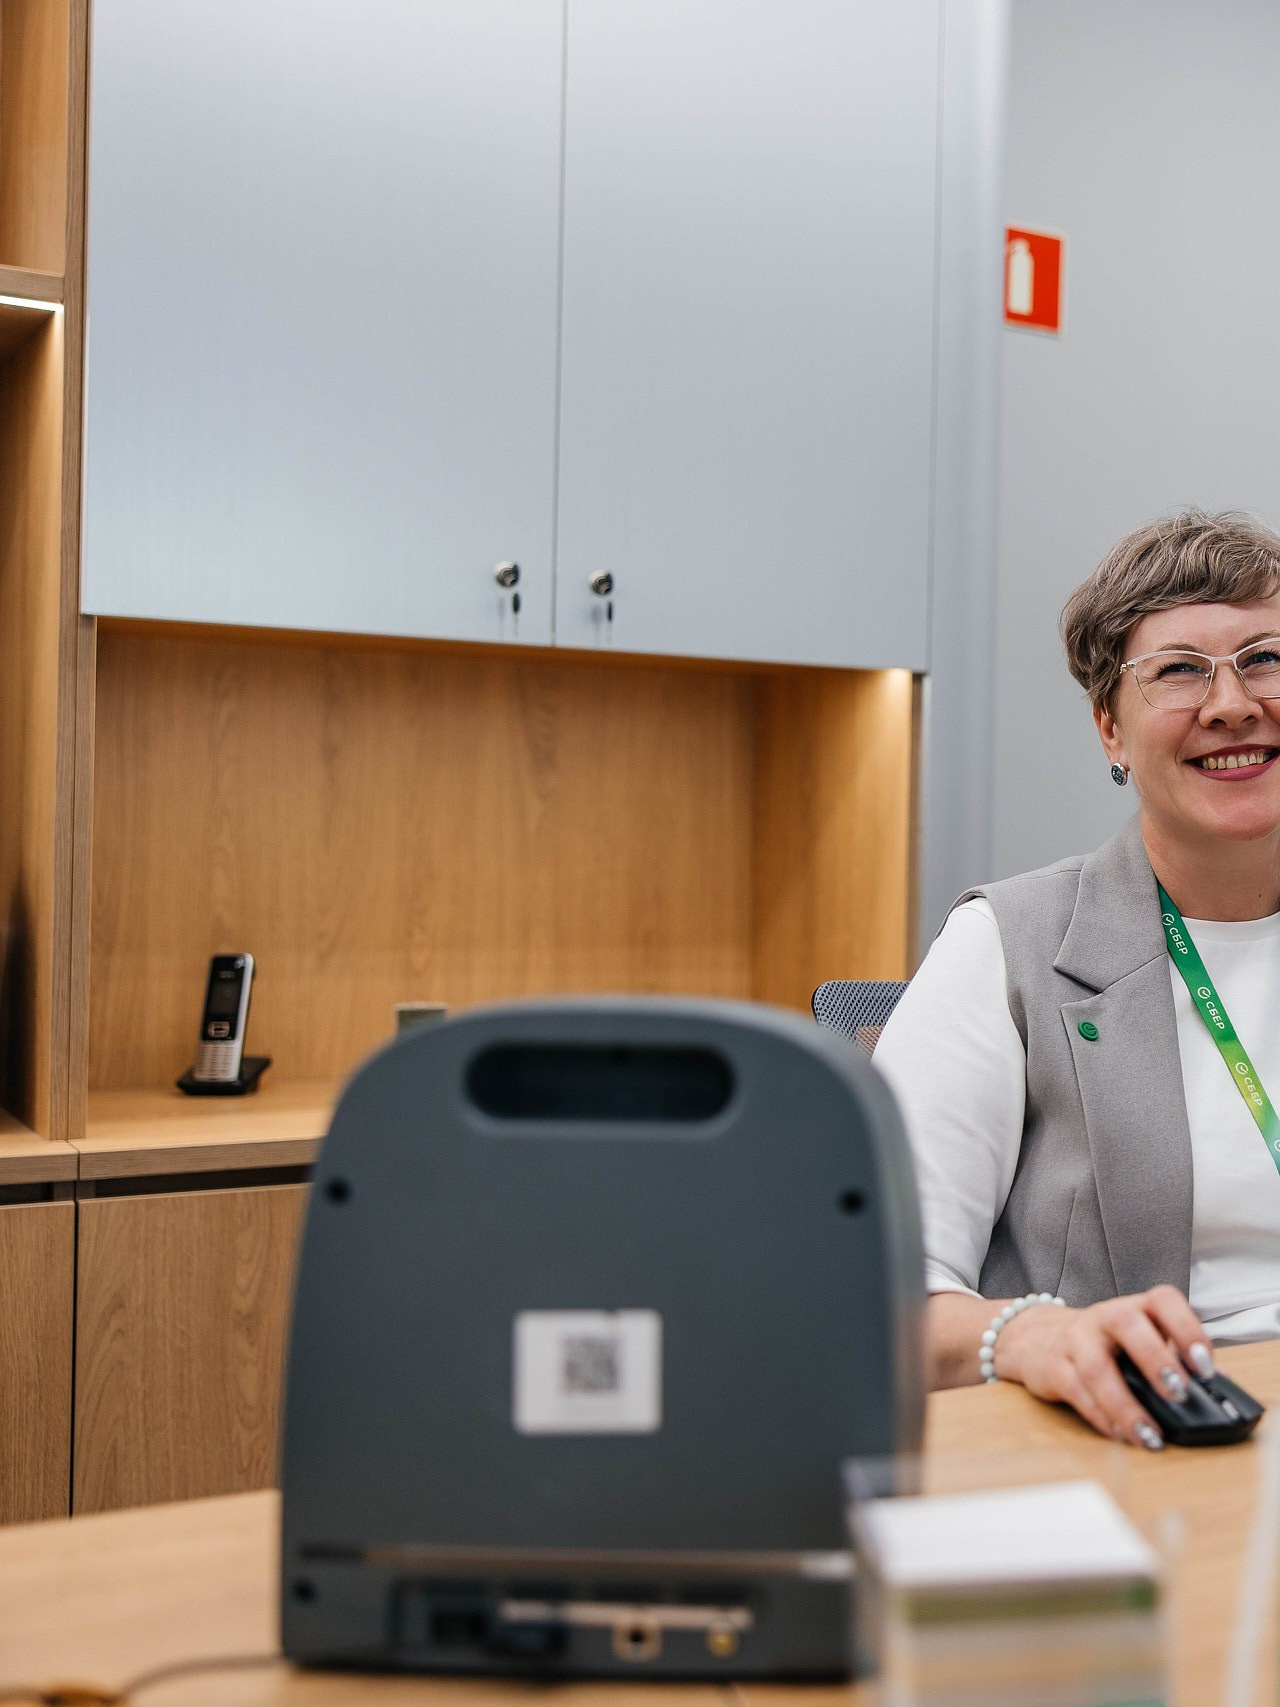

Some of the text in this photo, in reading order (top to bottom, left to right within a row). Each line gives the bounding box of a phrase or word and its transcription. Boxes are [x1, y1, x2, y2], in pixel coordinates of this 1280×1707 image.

[1168, 927, 1189, 955] СБЕР
[1205, 1001, 1225, 1030] СБЕР
[1244, 1077, 1263, 1106] СБЕР
